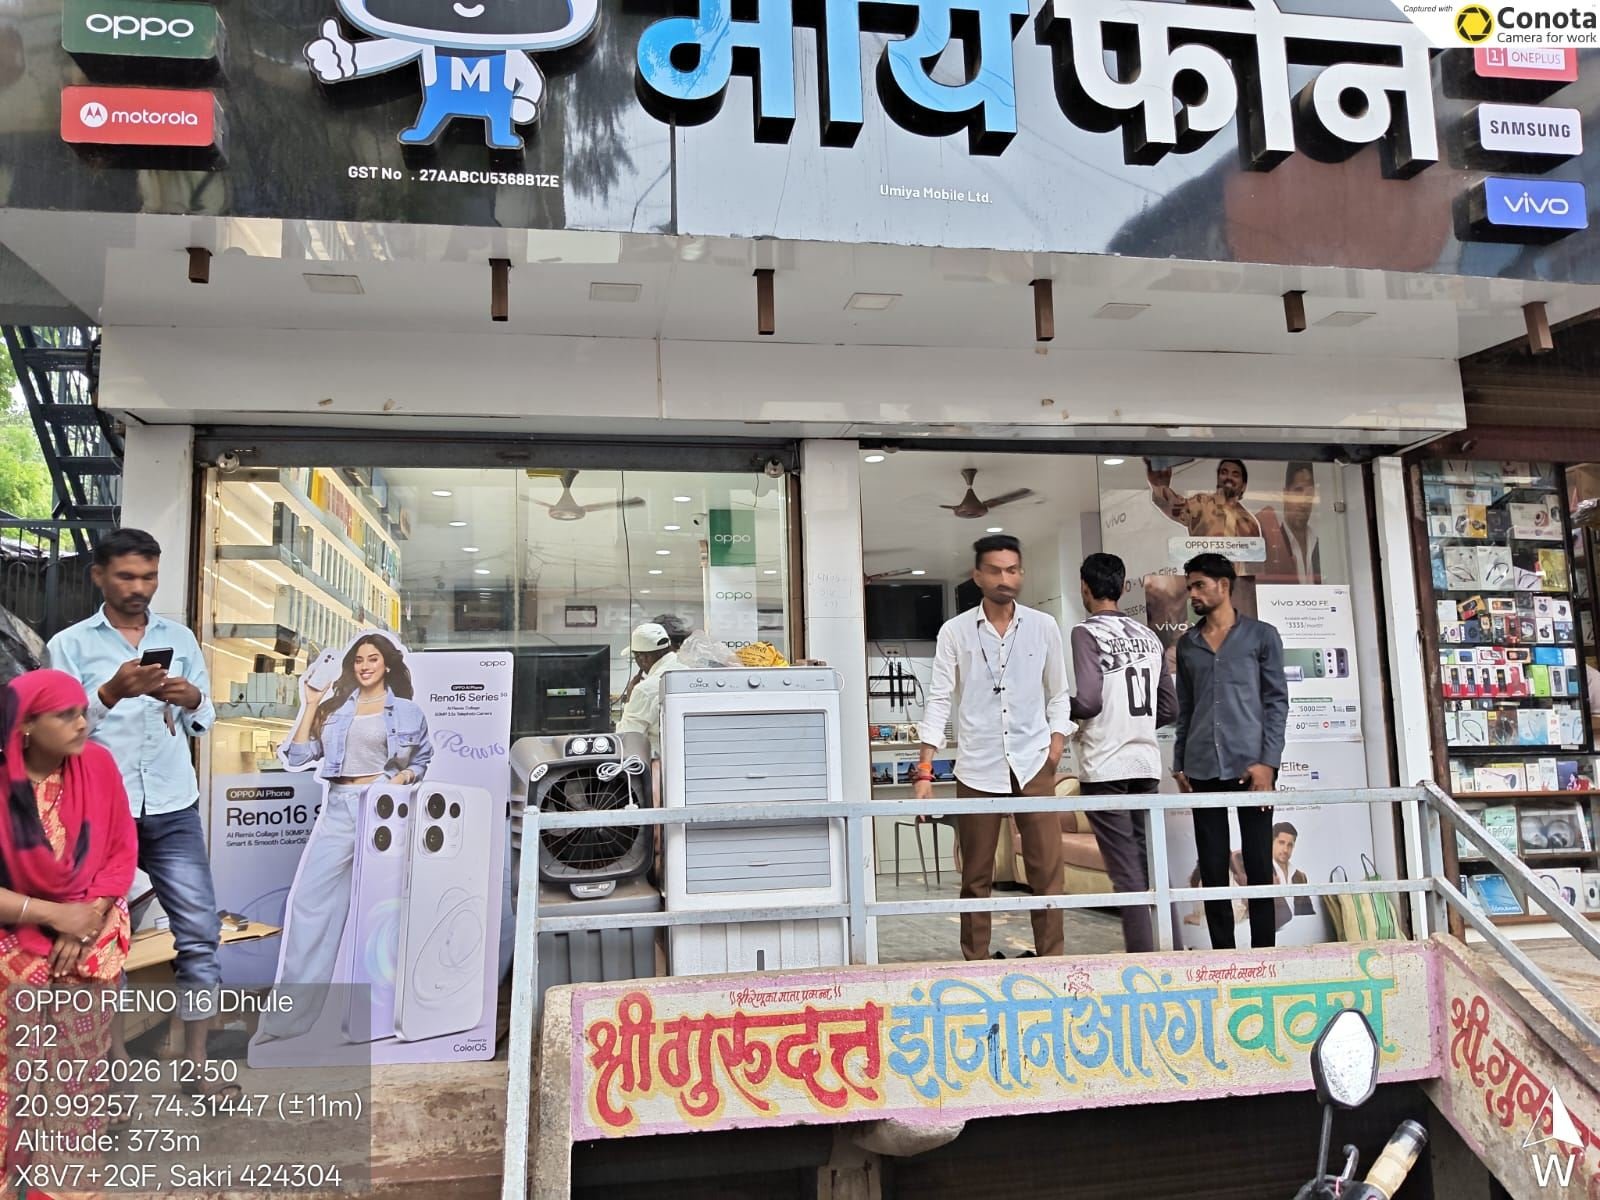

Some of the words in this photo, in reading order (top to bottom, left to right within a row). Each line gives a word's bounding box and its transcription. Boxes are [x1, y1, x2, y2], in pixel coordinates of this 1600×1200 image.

[1511, 51, 1561, 65] ONEPLUS
[451, 57, 490, 92] M
[111, 108, 198, 126] motorola
[1490, 119, 1571, 139] SAMSUNG
[348, 166, 379, 180] GST
[880, 184, 920, 199] Umiya
[923, 187, 965, 201] Mobile
[967, 190, 993, 203] Ltd.
[1503, 191, 1569, 215] vivo
[1105, 512, 1127, 529] vivo
[1185, 541, 1209, 549] OPPO
[1210, 541, 1225, 549] F33
[1226, 541, 1249, 549] Series
[1155, 621, 1188, 631] vivo
[430, 693, 466, 702] Reno16
[468, 692, 499, 702] Series
[1281, 761, 1309, 771] Elite
[230, 790, 255, 798] OPPO
[266, 789, 290, 797] Phone
[226, 804, 307, 826] Reno16
